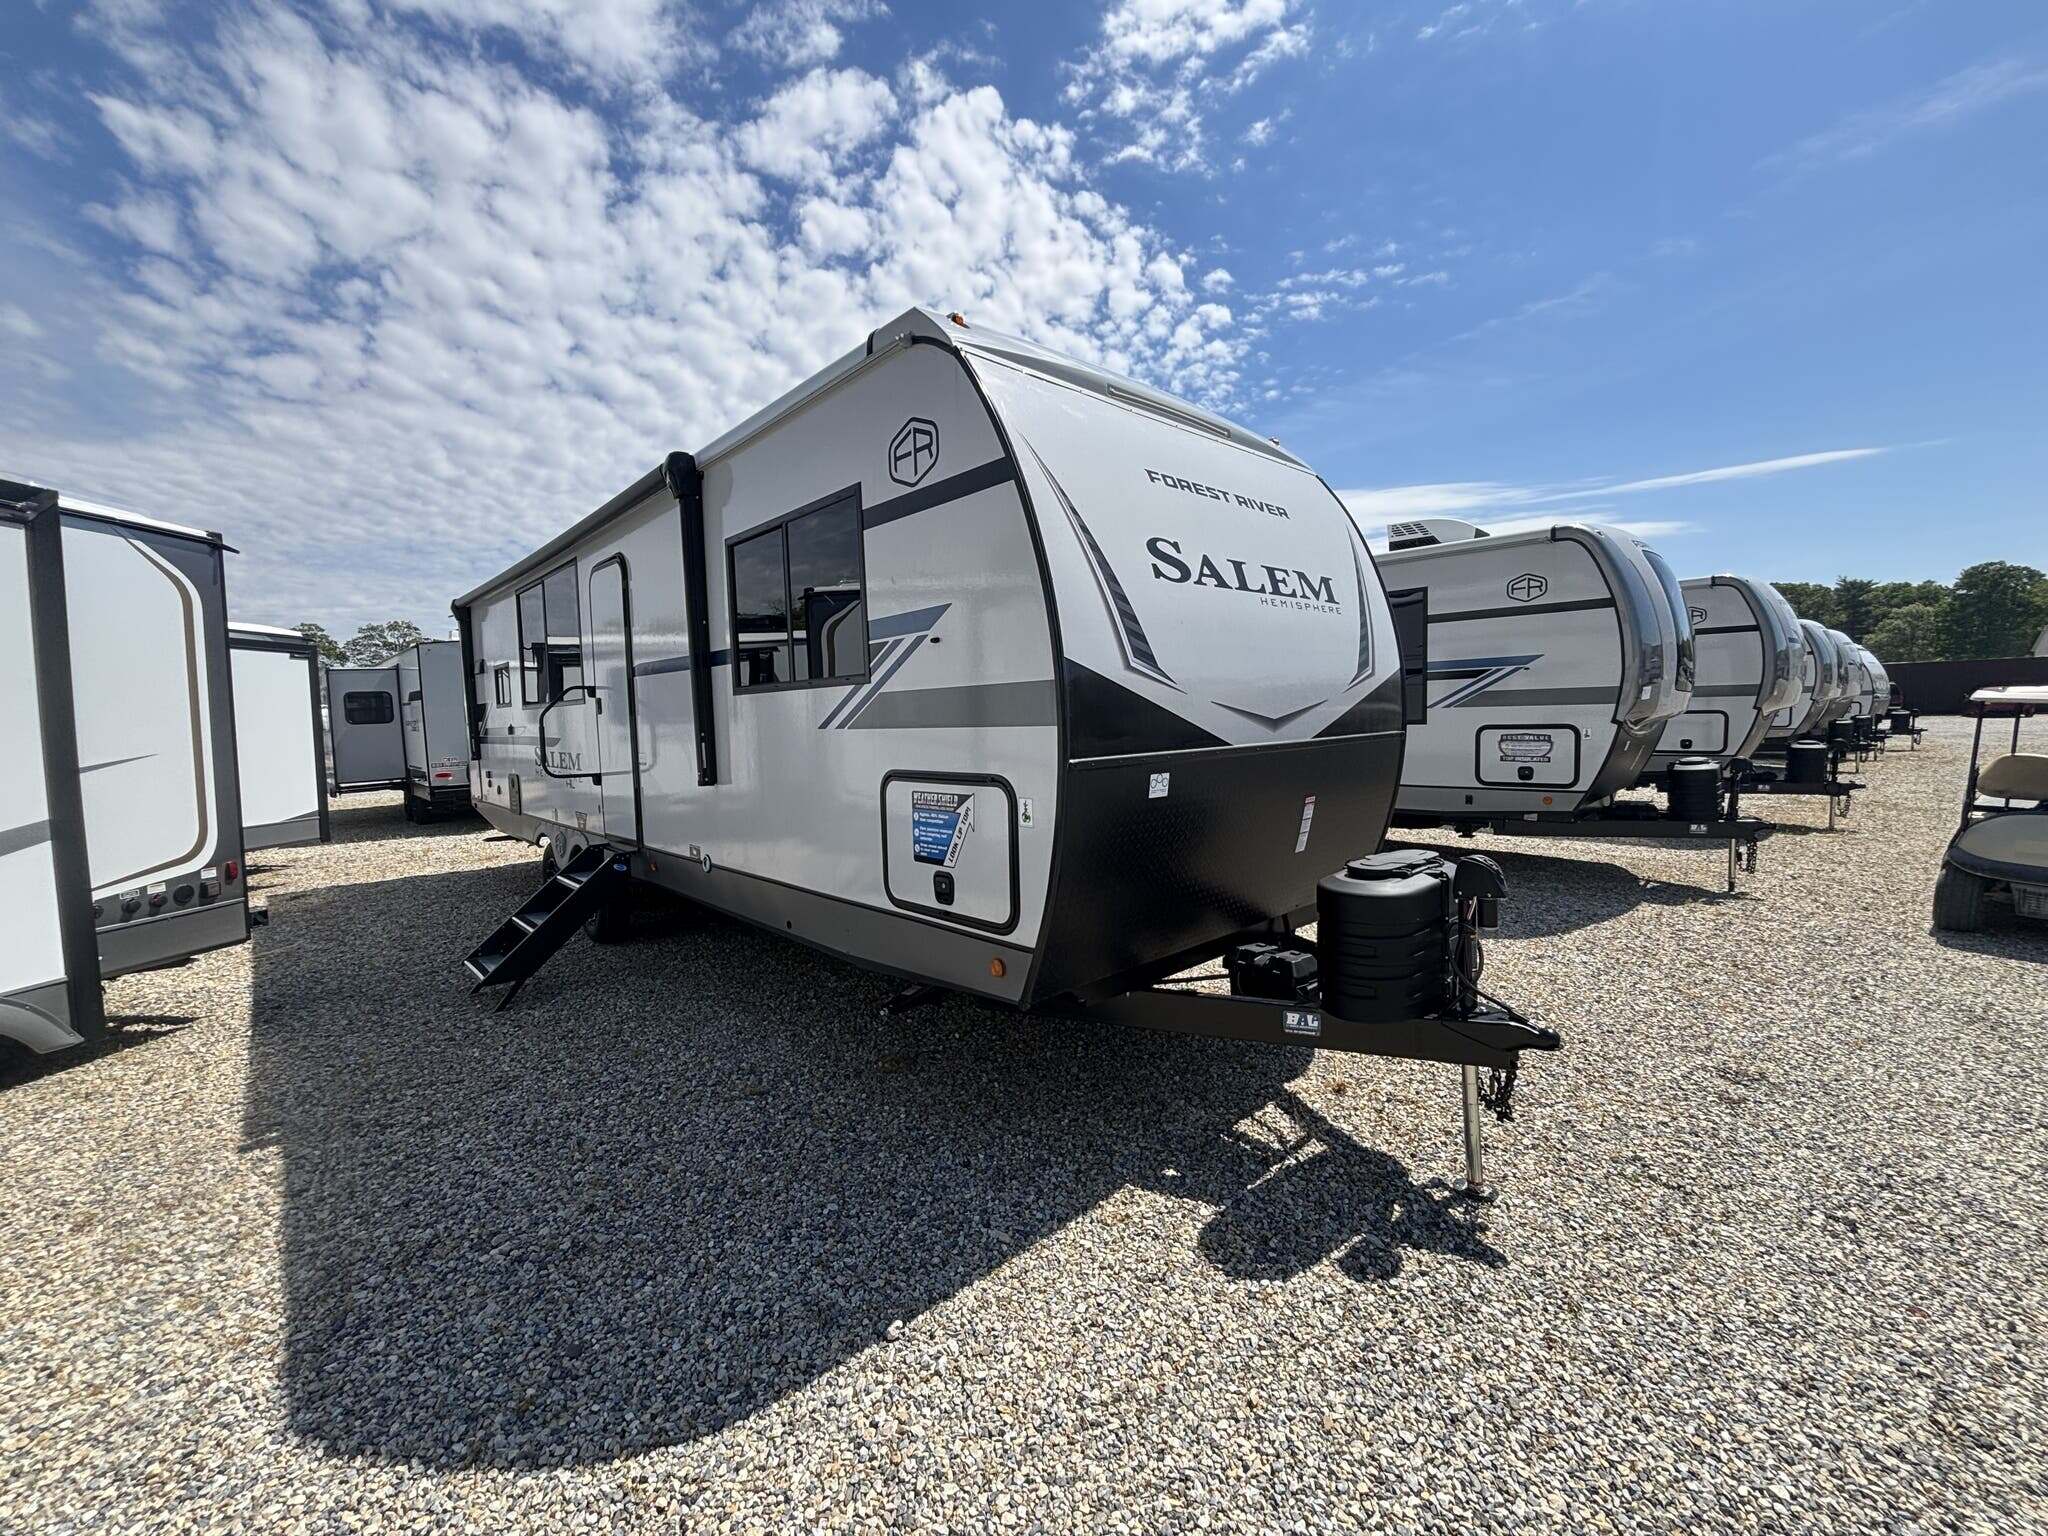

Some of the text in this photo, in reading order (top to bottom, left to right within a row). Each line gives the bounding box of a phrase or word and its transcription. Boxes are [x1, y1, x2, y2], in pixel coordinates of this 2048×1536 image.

[1144, 468, 1291, 520] FOREST RIVER
[1145, 536, 1340, 605] SALEM
[1260, 596, 1342, 615] HEMISPHERE
[938, 794, 958, 807] SHIELD
[948, 842, 959, 862] LOOK
[961, 806, 971, 825] TOP!
